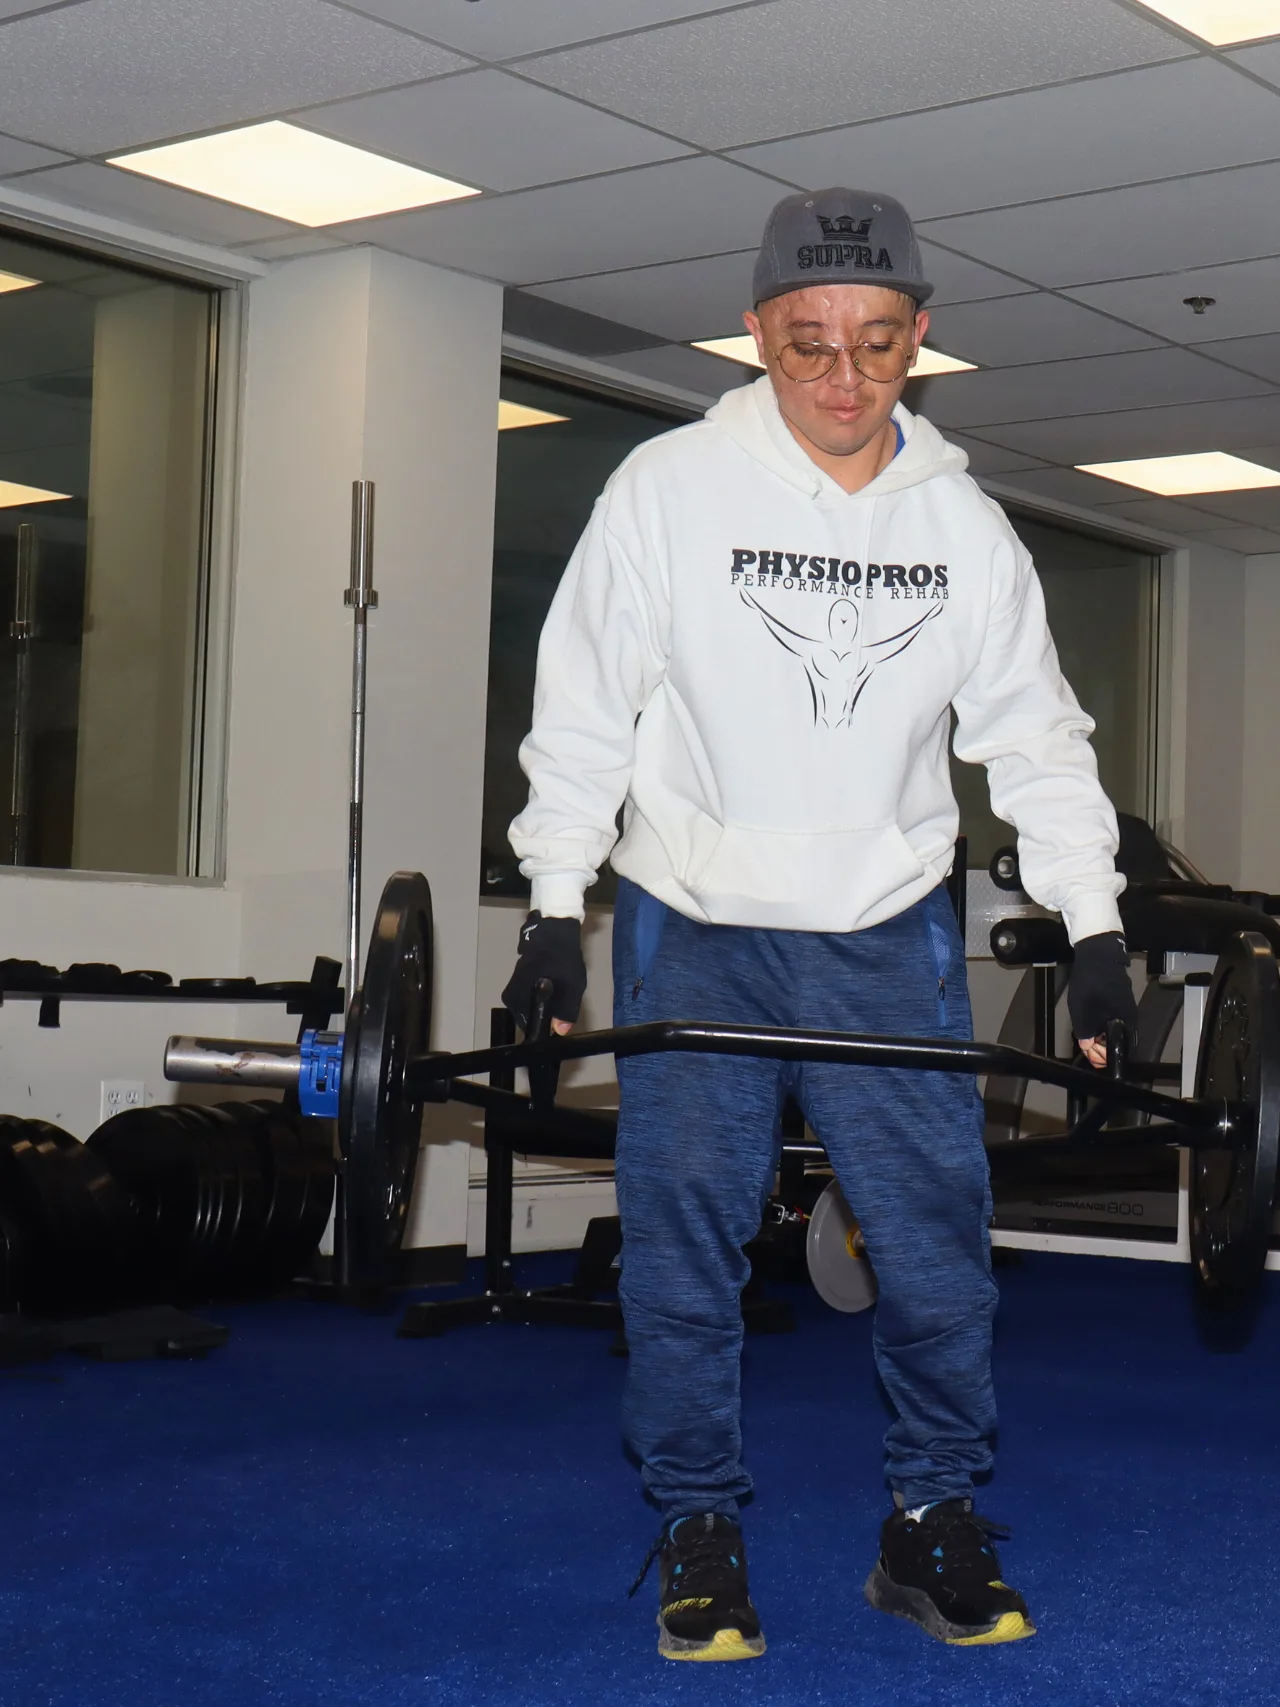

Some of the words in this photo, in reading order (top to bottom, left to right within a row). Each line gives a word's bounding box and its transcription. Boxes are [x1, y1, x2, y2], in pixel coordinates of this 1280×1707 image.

[797, 244, 893, 271] SUPRA
[731, 548, 948, 588] PHYSIOPROS
[731, 573, 874, 599] PERFORMANCE
[890, 587, 949, 600] REHAB
